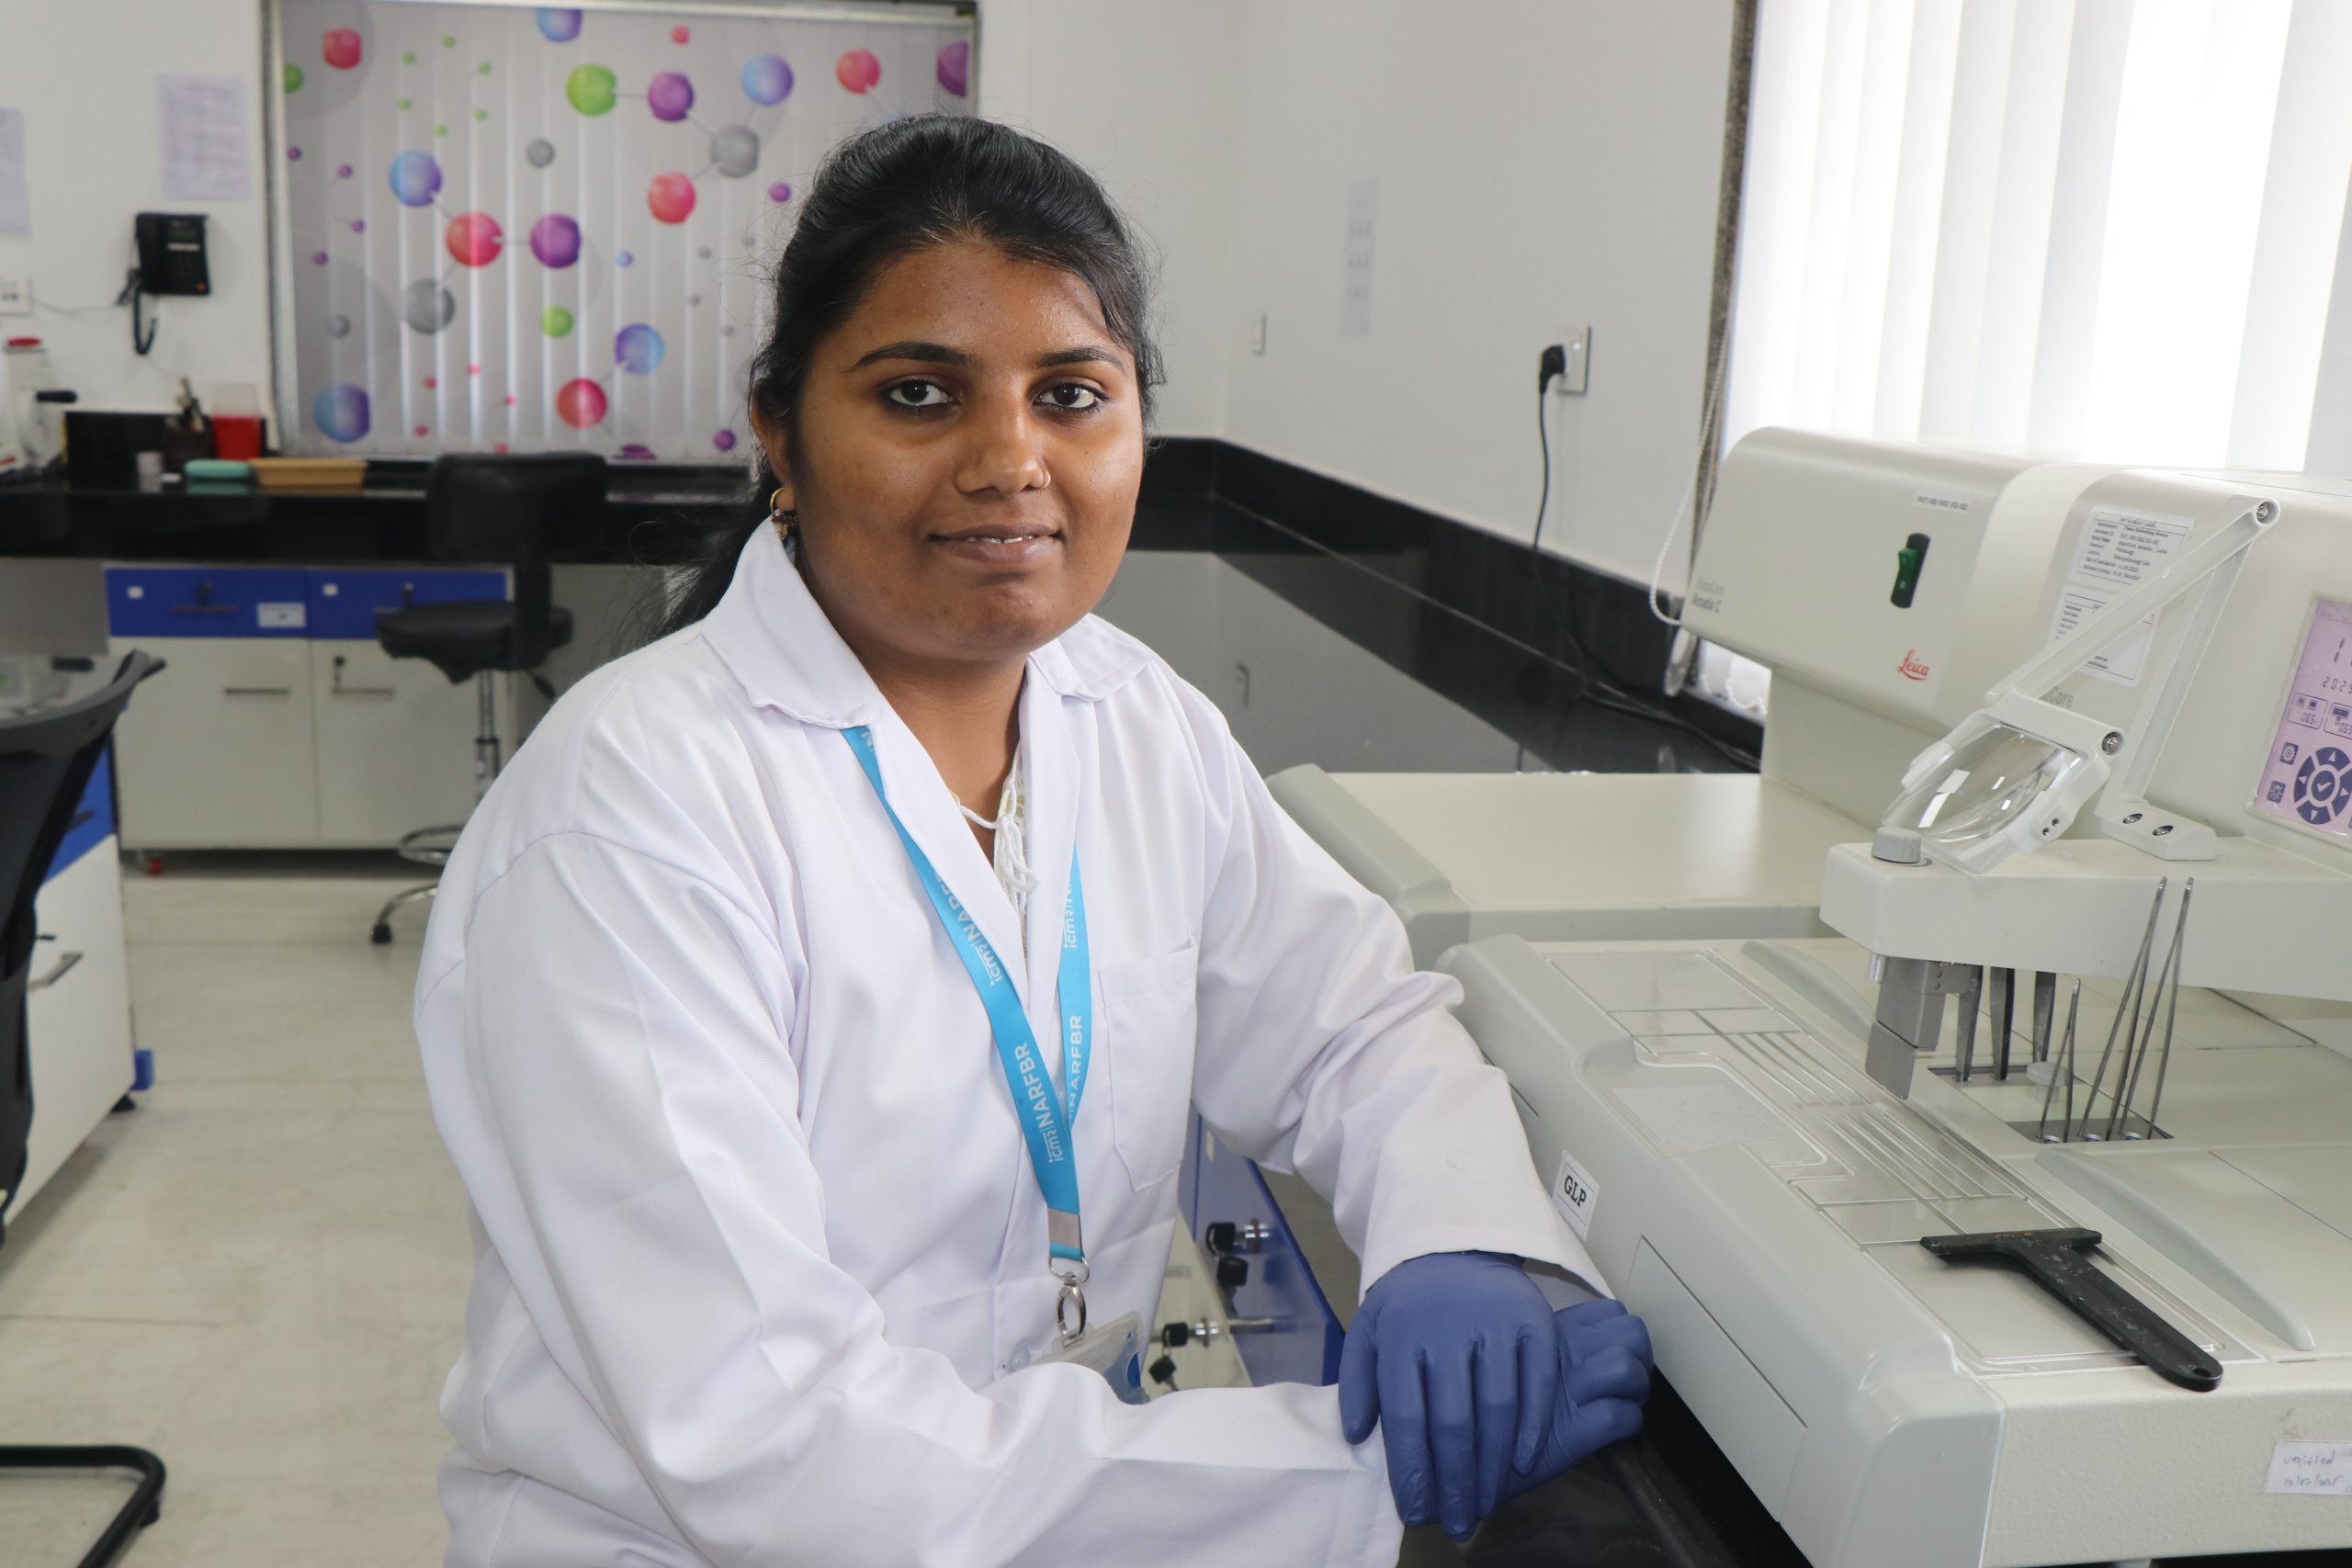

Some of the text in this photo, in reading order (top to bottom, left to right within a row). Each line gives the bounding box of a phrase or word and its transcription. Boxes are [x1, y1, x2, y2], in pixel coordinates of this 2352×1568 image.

[1896, 649, 1929, 681] Leica
[976, 942, 1003, 986] icmr
[1069, 1014, 1082, 1109] NARFBR
[1014, 1042, 1064, 1163] icmr NARFBR
[1565, 1175, 1587, 1208] GLP
